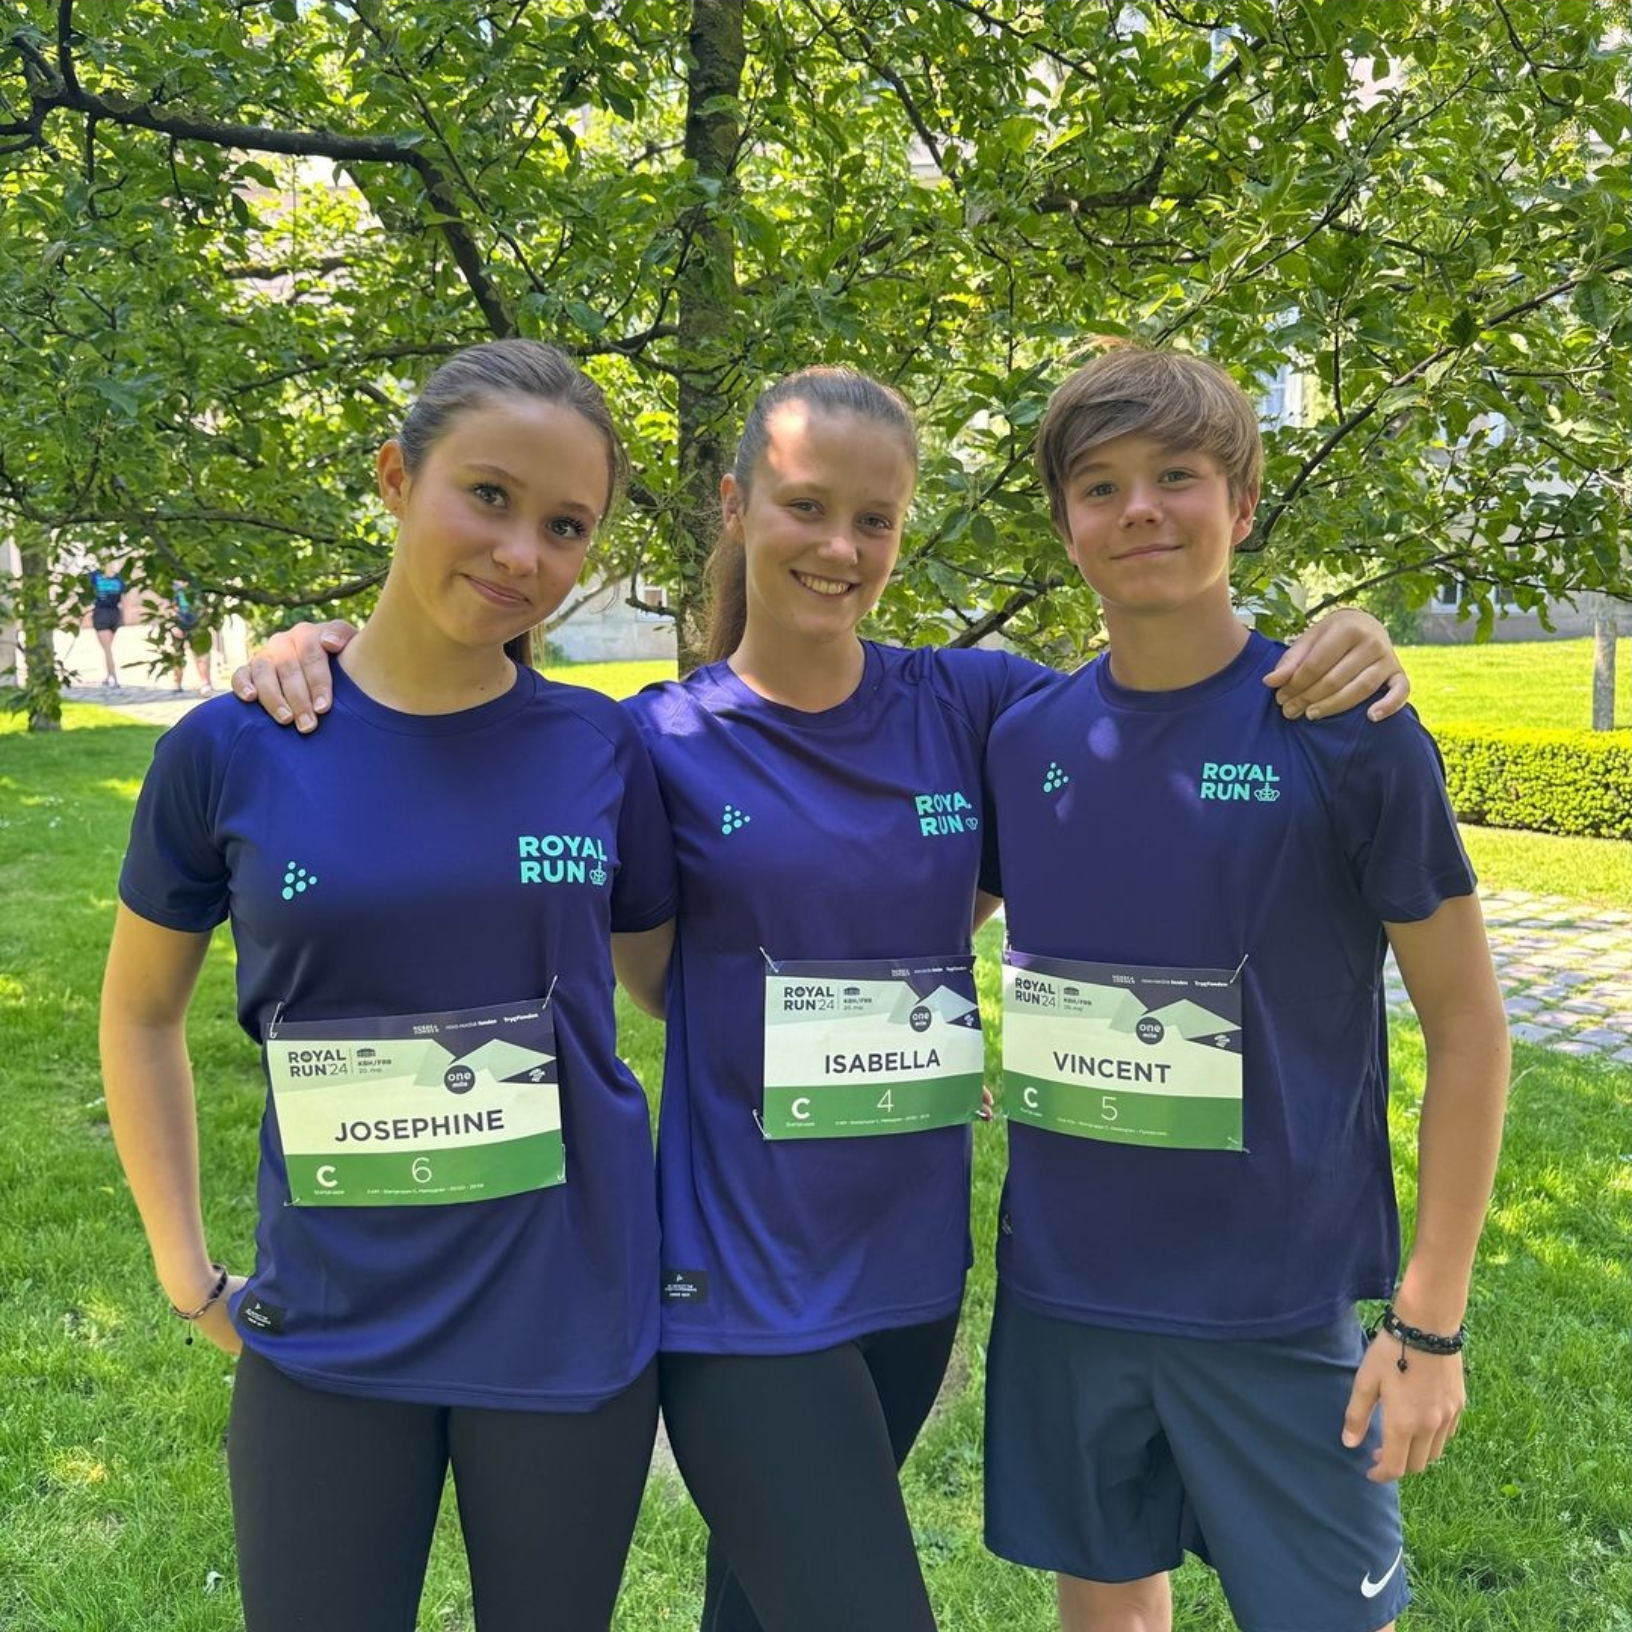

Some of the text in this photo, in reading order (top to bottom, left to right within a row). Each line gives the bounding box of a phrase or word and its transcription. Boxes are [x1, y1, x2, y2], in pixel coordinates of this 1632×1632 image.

[1203, 762, 1280, 782] ROYAL
[1200, 781, 1251, 801] RUN
[920, 814, 965, 836] RUN
[518, 835, 608, 862] ROYAL
[520, 860, 586, 884] RUN
[784, 986, 835, 998] ROYAL
[1015, 977, 1056, 995] ROYAL
[912, 1012, 929, 1021] one
[1139, 1024, 1161, 1033] one
[288, 1049, 347, 1064] ROYAL
[825, 1049, 941, 1074] ISABELLA
[1053, 1051, 1172, 1084] VINCENT
[447, 1072, 472, 1082] one
[791, 1089, 894, 1119] C 4
[1023, 1087, 1118, 1121] C 5
[334, 1109, 505, 1143] JOSEPHINE
[316, 1157, 433, 1188] C 6
